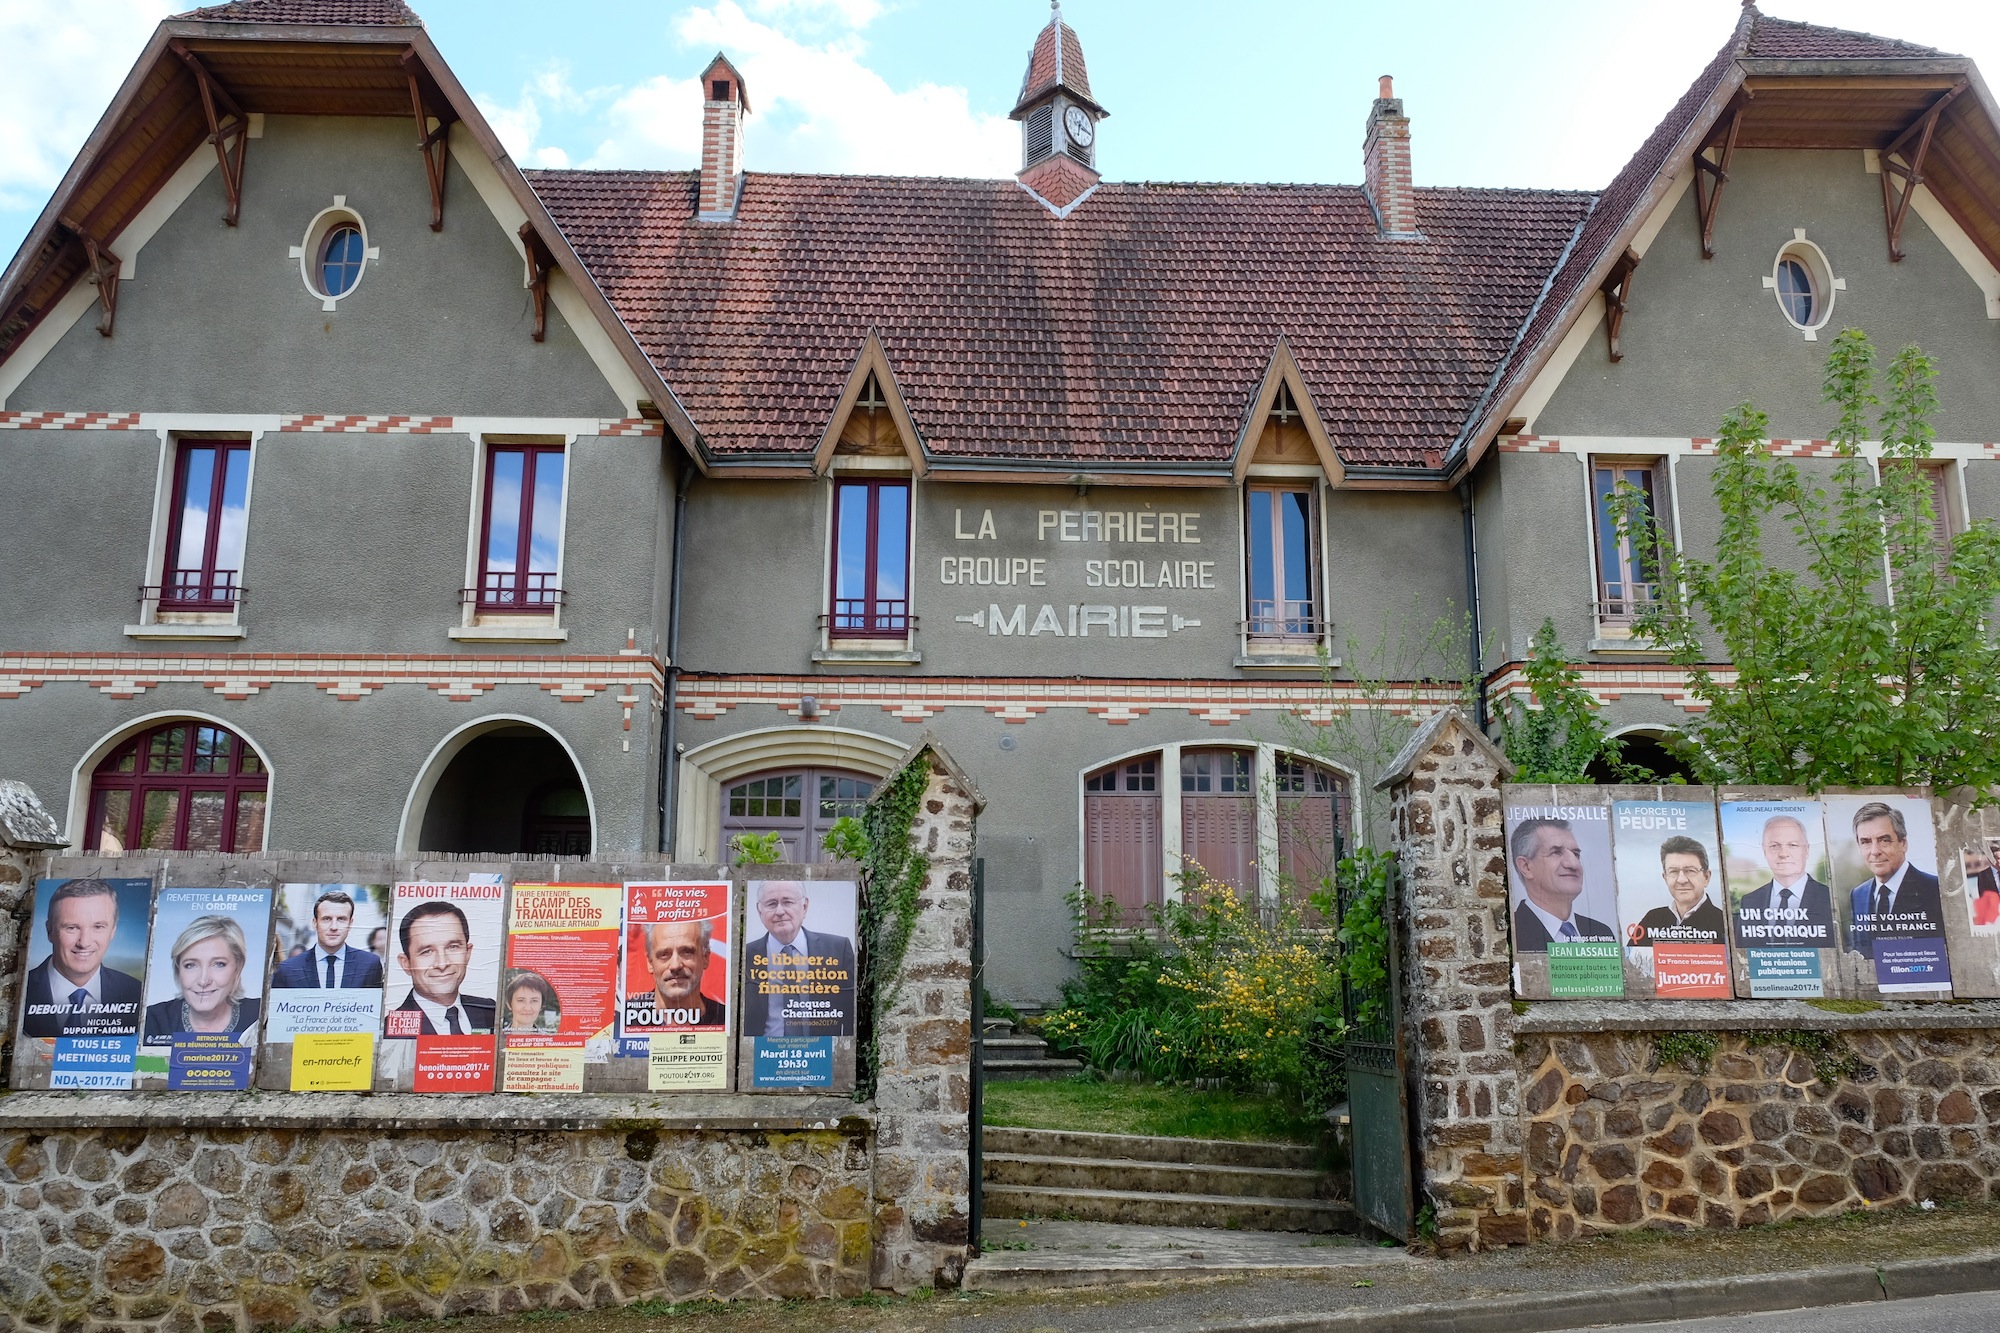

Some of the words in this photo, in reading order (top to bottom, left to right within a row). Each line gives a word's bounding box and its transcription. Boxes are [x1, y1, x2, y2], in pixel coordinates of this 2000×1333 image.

[955, 509, 997, 540] LA
[1038, 502, 1201, 543] PERRIÈRE
[940, 556, 1047, 586] GROUPE
[1086, 560, 1215, 589] SCOLAIRE
[988, 603, 1168, 638] MAIRIE
[1507, 807, 1539, 821] JEAN
[1544, 806, 1607, 821] LASSALLE
[1618, 807, 1631, 815] LA
[1635, 807, 1667, 816] FORCE
[1671, 807, 1686, 816] DU
[1619, 816, 1687, 830] PEUPLE
[398, 885, 447, 898] BENOIT
[450, 886, 502, 898] HAMON
[664, 887, 684, 898] Nos
[685, 887, 708, 899] vies,
[166, 893, 211, 902] REMETTRE
[212, 894, 224, 902] LA
[227, 894, 264, 902] FRANCE
[191, 902, 204, 911] EN
[206, 902, 238, 911] ORDRE
[516, 897, 530, 909] LE
[532, 897, 566, 908] CAMP
[568, 897, 591, 908] DES
[655, 900, 674, 910] pas
[675, 898, 701, 908] leurs
[515, 908, 603, 920] TRAVAILLEURS
[631, 906, 648, 914] NPA
[1740, 908, 1761, 920] UN
[1763, 908, 1809, 921] CHOIX
[1856, 913, 1877, 922] UNE
[1879, 911, 1927, 921] VOLONTÉ
[514, 920, 533, 928] AVEC
[534, 920, 566, 928] NATHALIE
[567, 920, 600, 928] ARTHAUD
[1850, 924, 1878, 932] POUR
[1880, 923, 1893, 931] LA
[1896, 922, 1937, 931] FRANCE
[1647, 927, 1718, 939] Mélenchon
[1741, 925, 1827, 938] HISTORIQUE
[1550, 946, 1573, 957] JEAN
[1575, 946, 1619, 957] LASSALLE
[1750, 950, 1789, 958] Retrouvez
[1790, 950, 1815, 958] toutes
[753, 954, 769, 966] Se
[771, 954, 824, 966] libérer
[825, 957, 839, 966] de
[1757, 968, 1795, 976] publiques
[1890, 964, 1934, 973] fillon2017.fr
[1579, 972, 1609, 980] publiques
[1657, 971, 1726, 987] jlm2017.fr
[758, 982, 841, 994] financière
[1552, 985, 1622, 994] jeanlassalle2017.fr
[1754, 984, 1820, 992] asselineau2017.fr
[627, 991, 655, 1000] VOTEZ
[28, 1003, 72, 1015] DEBOUT
[72, 1003, 86, 1014] LA
[276, 1002, 320, 1013] Macron
[323, 1001, 374, 1013] Président
[626, 1001, 657, 1009] PHILIPPE
[786, 999, 831, 1011] Jacques
[626, 1008, 701, 1025] POUTOU
[781, 1009, 844, 1019] Cheminade
[87, 1018, 122, 1026] NICOLAS
[305, 1015, 328, 1024] France
[329, 1015, 342, 1024] doit
[343, 1016, 357, 1024] être
[388, 1017, 398, 1028] LE
[399, 1017, 421, 1028] CŒUR
[63, 1026, 136, 1035] DUPONT-AIGNAN
[300, 1024, 325, 1032] chance
[326, 1026, 343, 1034] pour
[394, 1027, 402, 1035] LA
[72, 1039, 99, 1049] TOUS
[100, 1040, 121, 1049] LES
[57, 1053, 108, 1062] MEETINGS
[109, 1054, 131, 1063] SUR
[183, 1054, 239, 1062] marine2017.fr
[652, 1055, 688, 1063] PHILIPPE
[689, 1054, 723, 1062] POUTOU
[760, 1049, 789, 1059] Mardi
[790, 1049, 802, 1059] 18
[803, 1049, 826, 1059] avril
[302, 1055, 362, 1067] en-marche.fr
[778, 1059, 808, 1069] 19h30
[418, 1063, 490, 1072] benoithamon2017.fr
[54, 1075, 127, 1086] NDA-2017.fr
[506, 1082, 580, 1091] nathalie-arthaud.info
